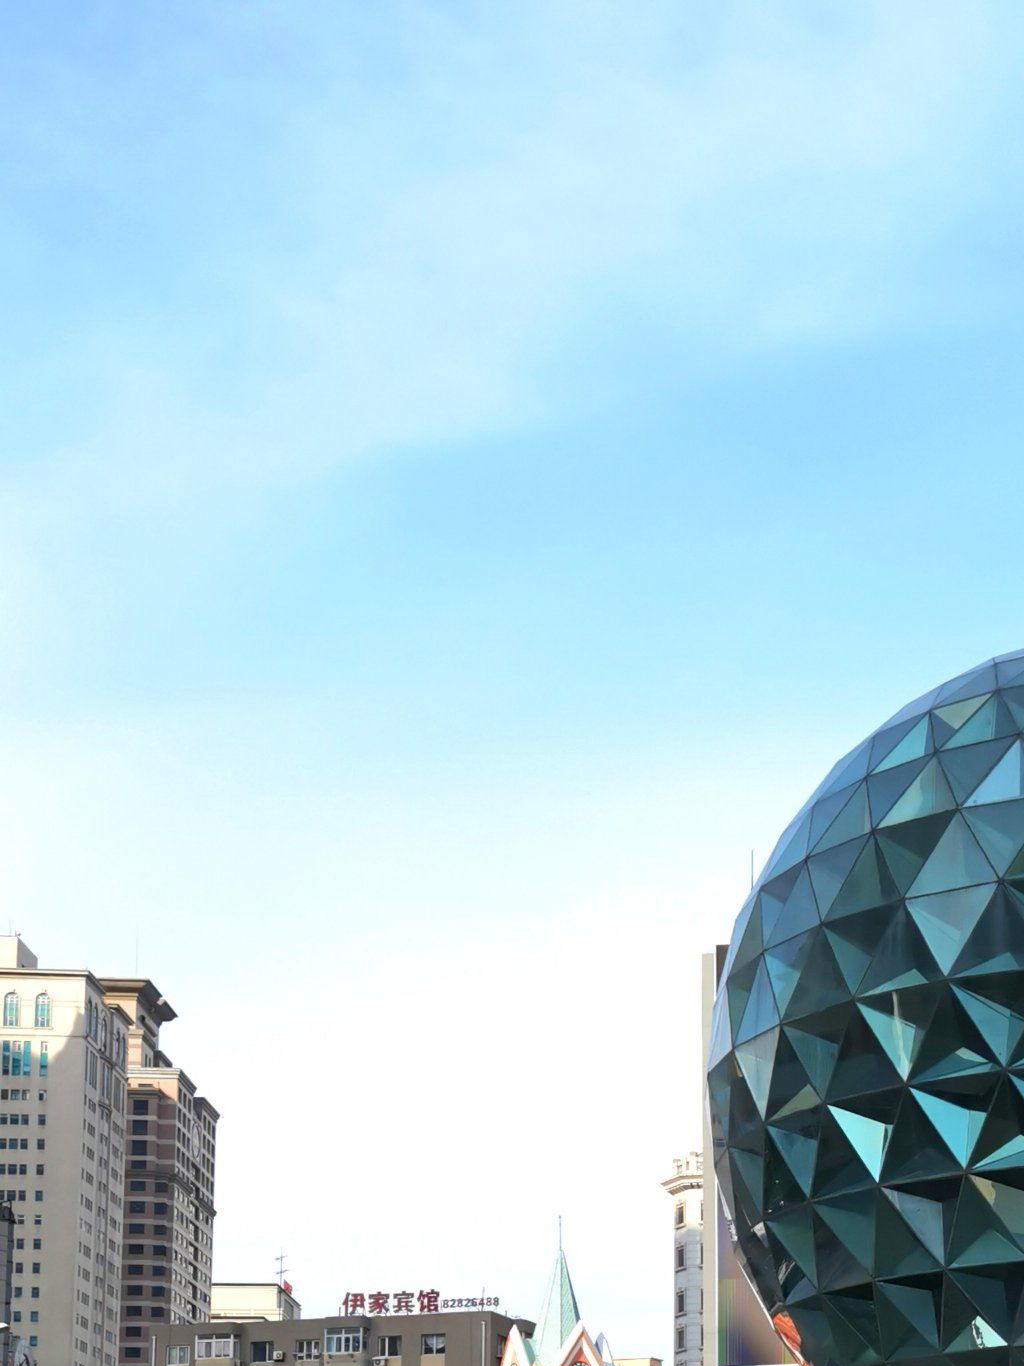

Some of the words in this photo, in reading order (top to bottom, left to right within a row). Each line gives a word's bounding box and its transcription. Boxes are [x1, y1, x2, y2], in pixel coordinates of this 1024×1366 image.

[342, 1289, 440, 1315] 伊家宾馆
[443, 1296, 500, 1309] 82826488
